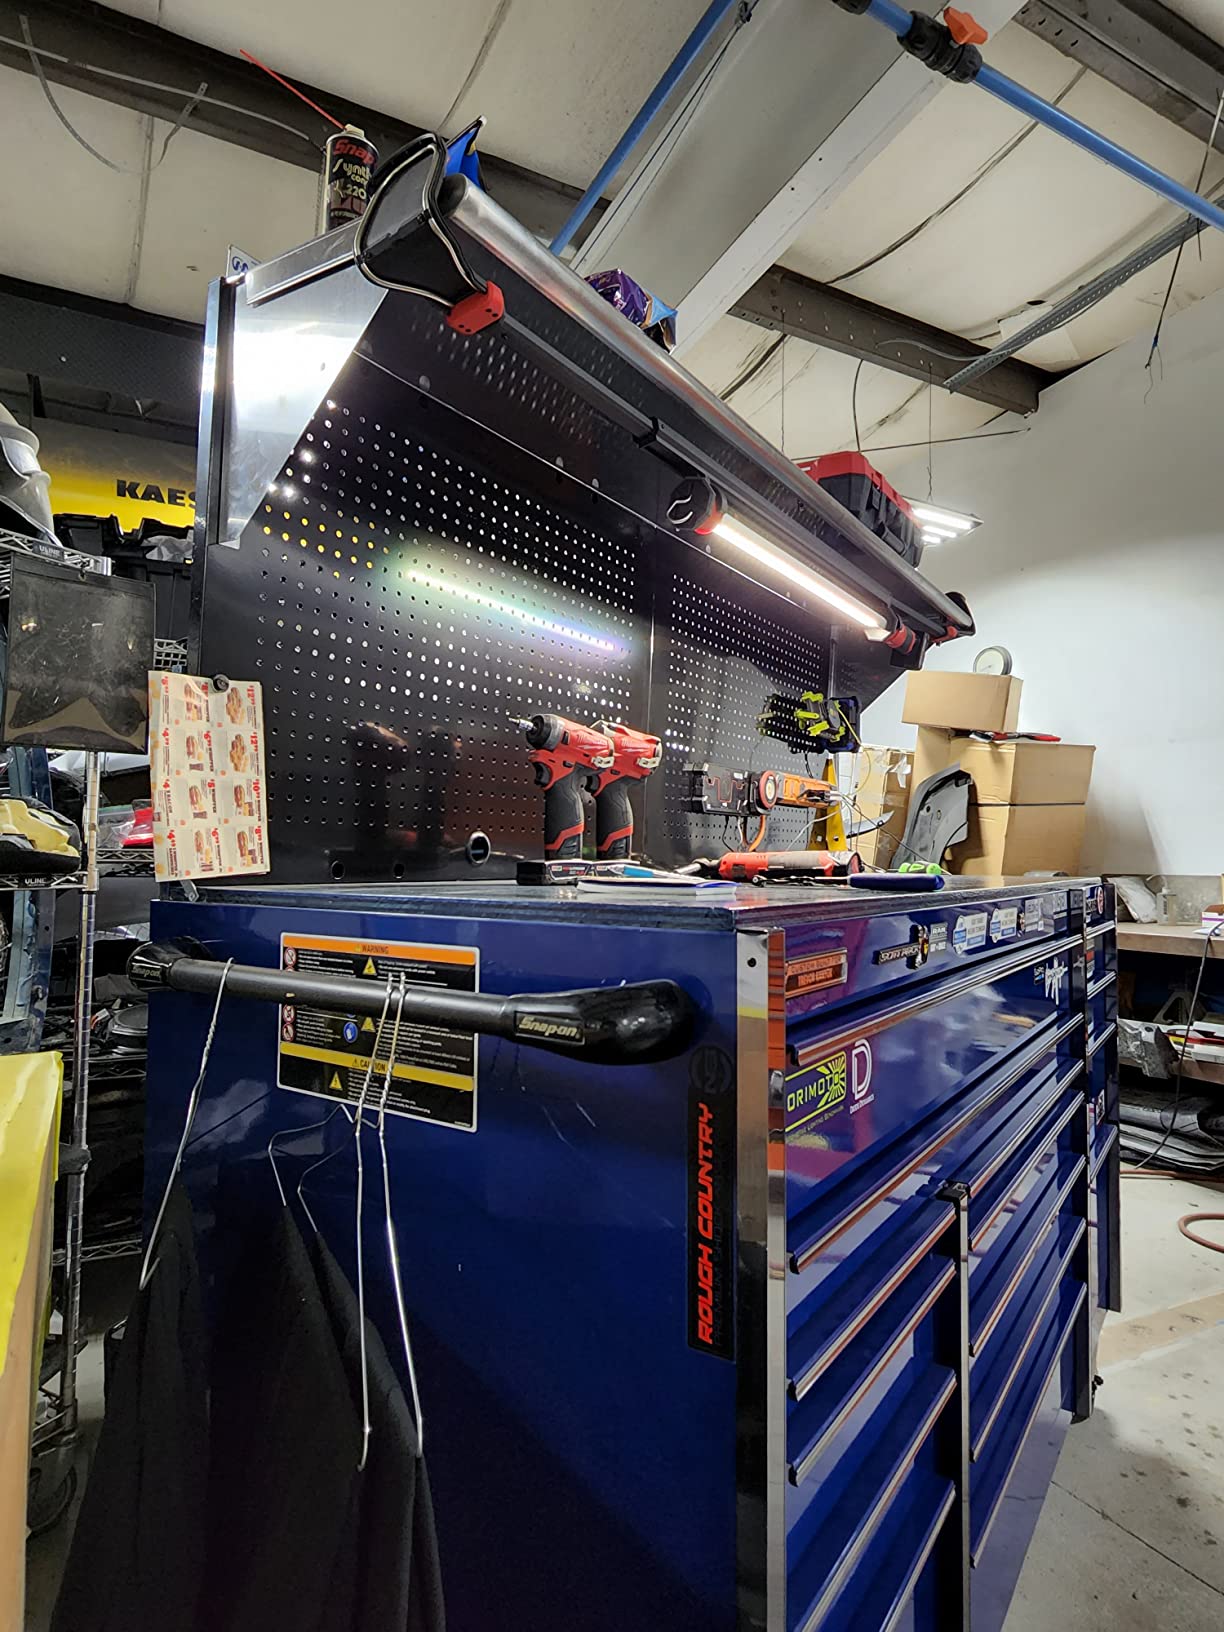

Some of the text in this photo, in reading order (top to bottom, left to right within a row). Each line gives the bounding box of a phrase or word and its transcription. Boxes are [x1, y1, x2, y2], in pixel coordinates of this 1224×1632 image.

[333, 139, 375, 164] Snap
[345, 184, 367, 200] 220
[362, 944, 389, 955] WARNING
[519, 1016, 578, 1037] Snap-on
[360, 1059, 386, 1071] CAION
[697, 1102, 713, 1345] ROUGH COUNTRY
